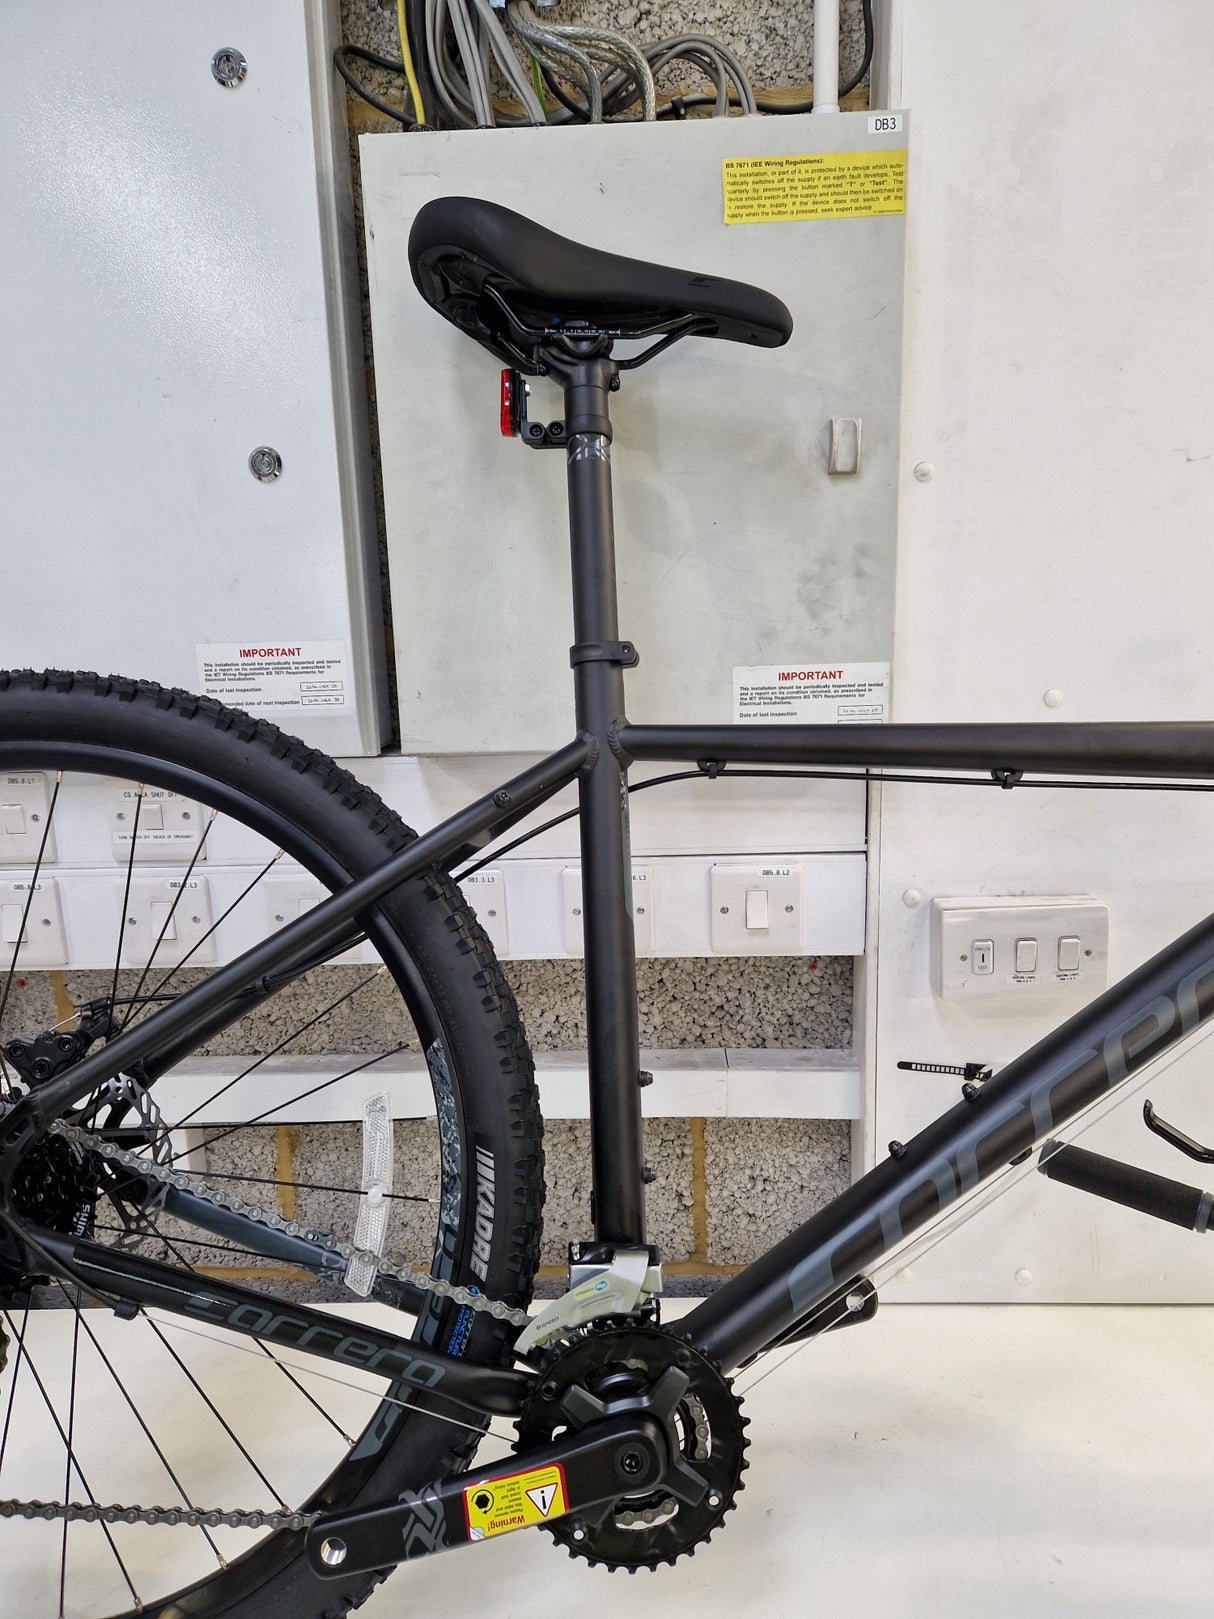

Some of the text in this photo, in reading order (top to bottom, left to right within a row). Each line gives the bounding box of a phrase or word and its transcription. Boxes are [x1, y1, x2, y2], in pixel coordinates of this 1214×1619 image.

[875, 118, 896, 130] DB3
[239, 648, 301, 658] IMPORTANT
[778, 670, 844, 681] IMPORTANT
[468, 1178, 496, 1283] KADRE
[488, 1515, 525, 1532] Warning!
